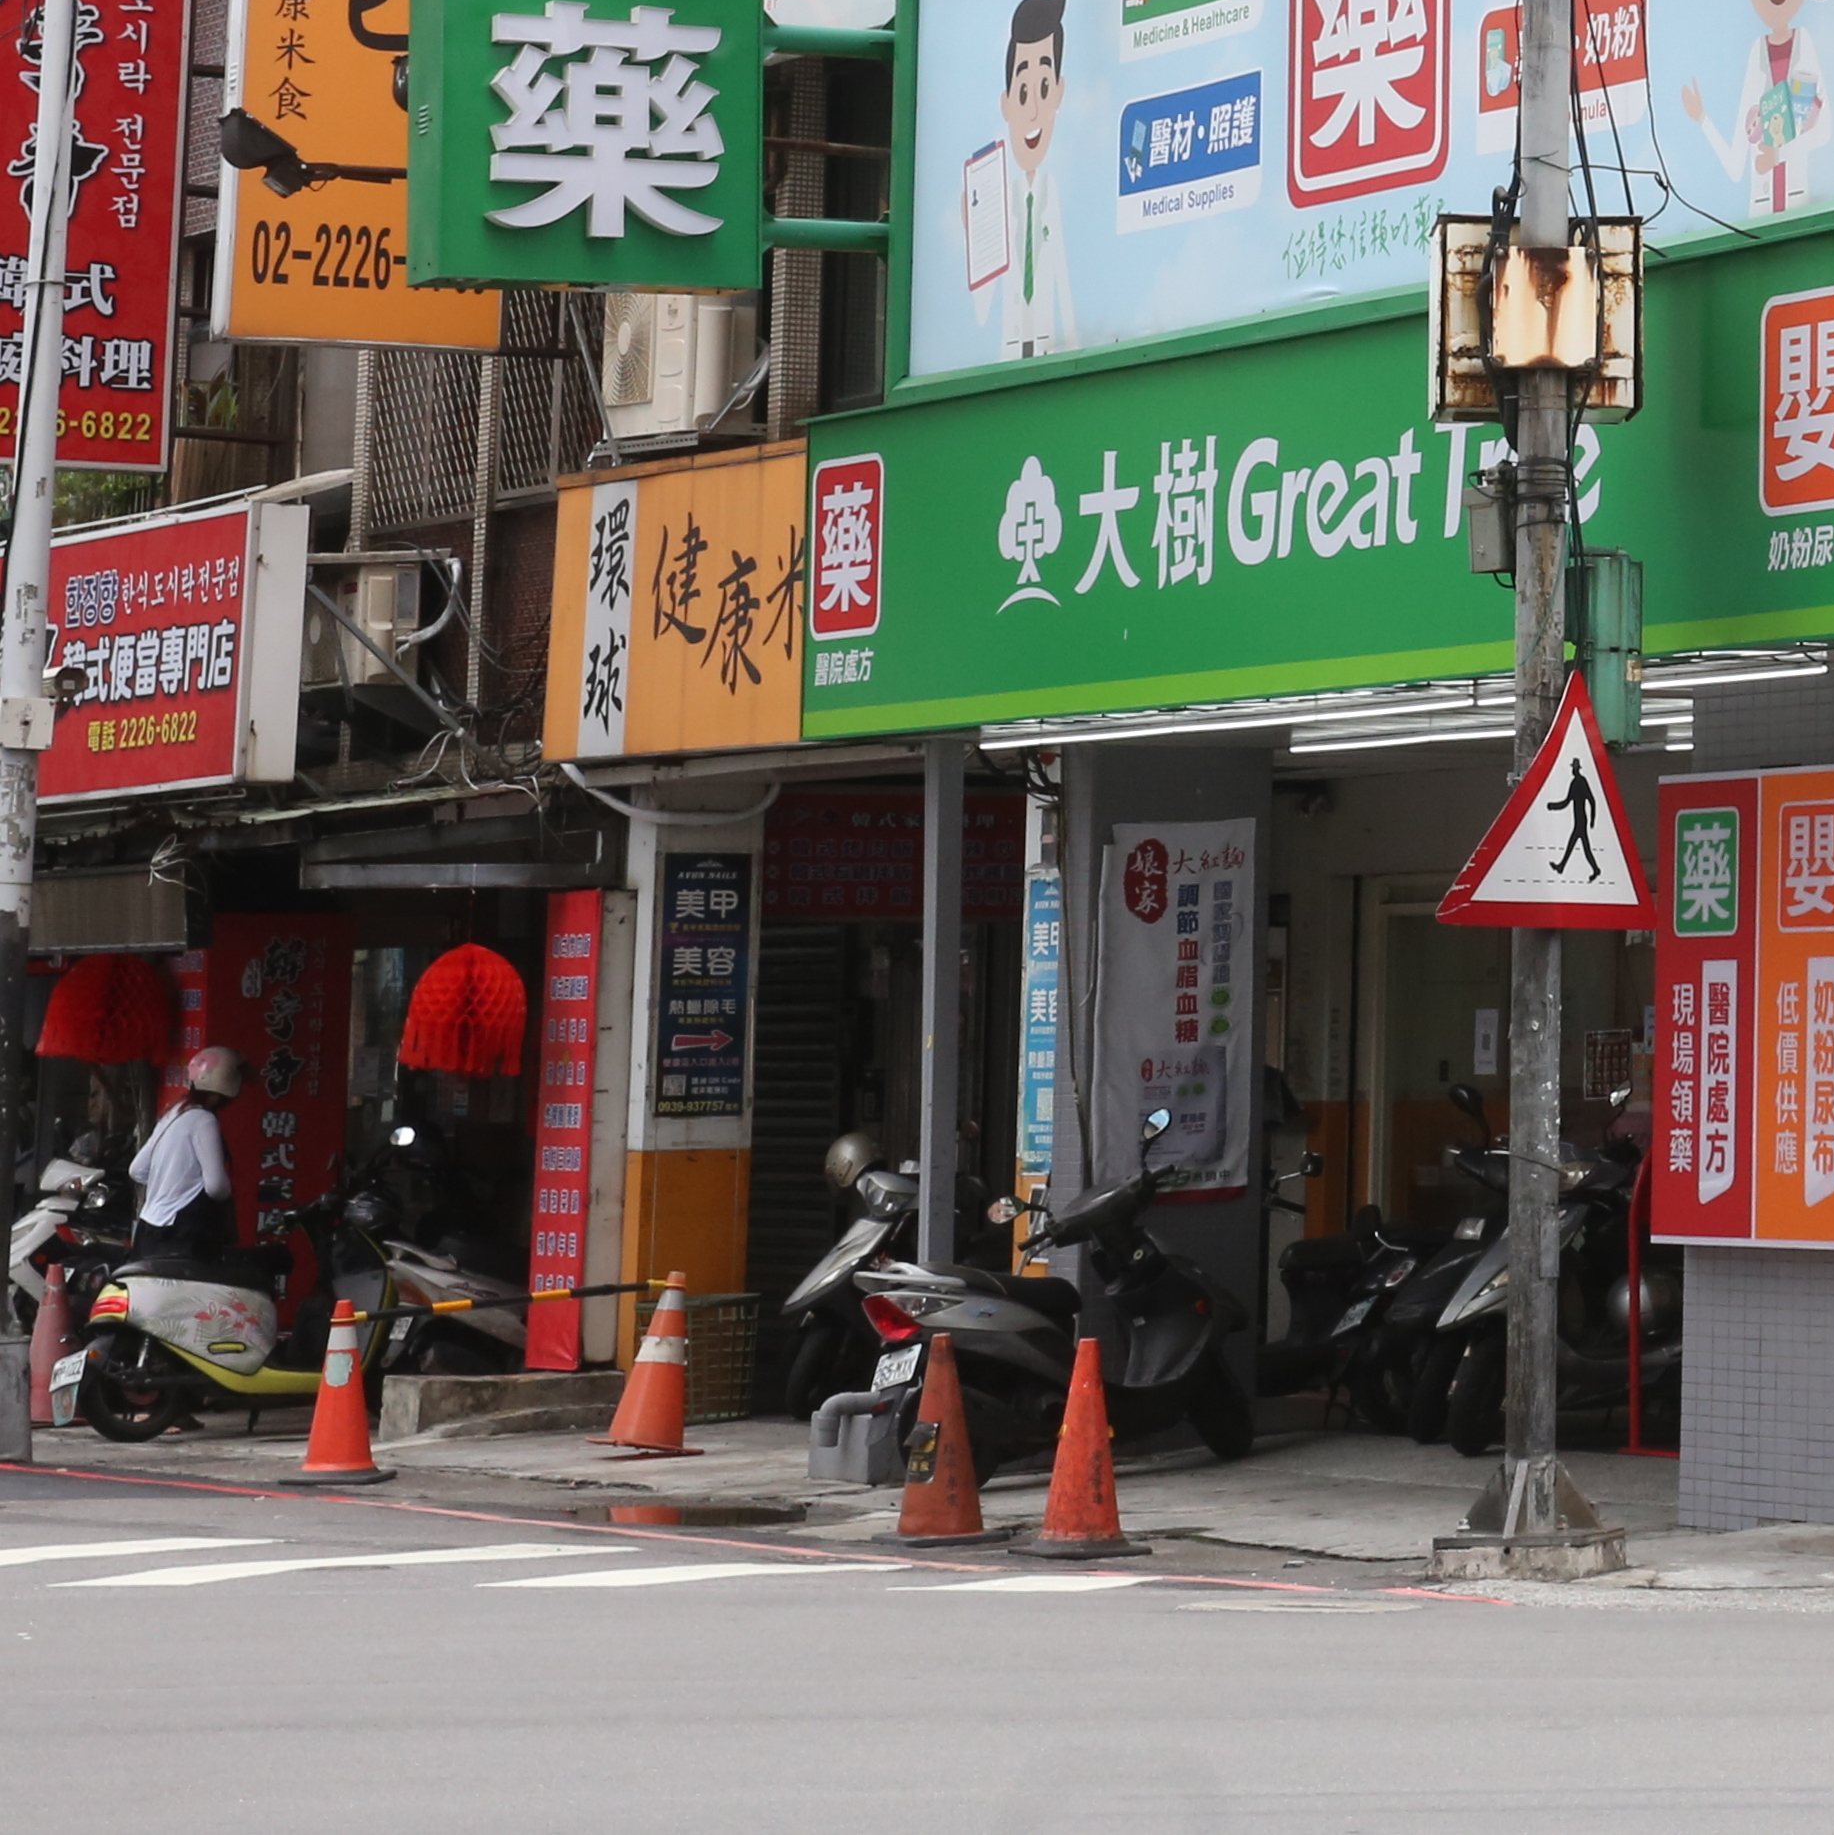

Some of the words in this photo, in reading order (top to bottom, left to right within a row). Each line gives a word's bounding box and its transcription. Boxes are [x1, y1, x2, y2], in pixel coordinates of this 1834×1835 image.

[1132, 23, 1182, 49] Medicine
[1181, 17, 1190, 37] &
[1190, 4, 1251, 35] Healthcare
[484, 0, 725, 238] 藥
[108, 114, 146, 229] 전문점
[1141, 185, 1184, 218] Medical
[1186, 179, 1236, 210] Supplies
[1284, 194, 1449, 282] 值得您信賴的藥
[820, 484, 874, 611] 藥
[1075, 435, 1218, 595] 大樹
[1228, 428, 1422, 568] Great
[65, 568, 120, 629] 한정향
[582, 497, 631, 739] 環球
[814, 648, 873, 689] 醫院處方
[87, 720, 116, 753] 電話
[118, 709, 198, 749] 2226-6822
[1128, 845, 1165, 915] 娘家
[1171, 842, 1246, 875] 大紅麴
[1683, 822, 1731, 923] 藥
[675, 889, 739, 919] 美甲
[672, 946, 736, 977] 美容
[1174, 882, 1201, 1044] 調節血脂血糖
[657, 1099, 725, 1113] 0939-937757
[1669, 981, 1695, 1175] 現場領藥
[1705, 981, 1731, 1175] 醫院處方
[1774, 980, 1801, 1175] 低價供應
